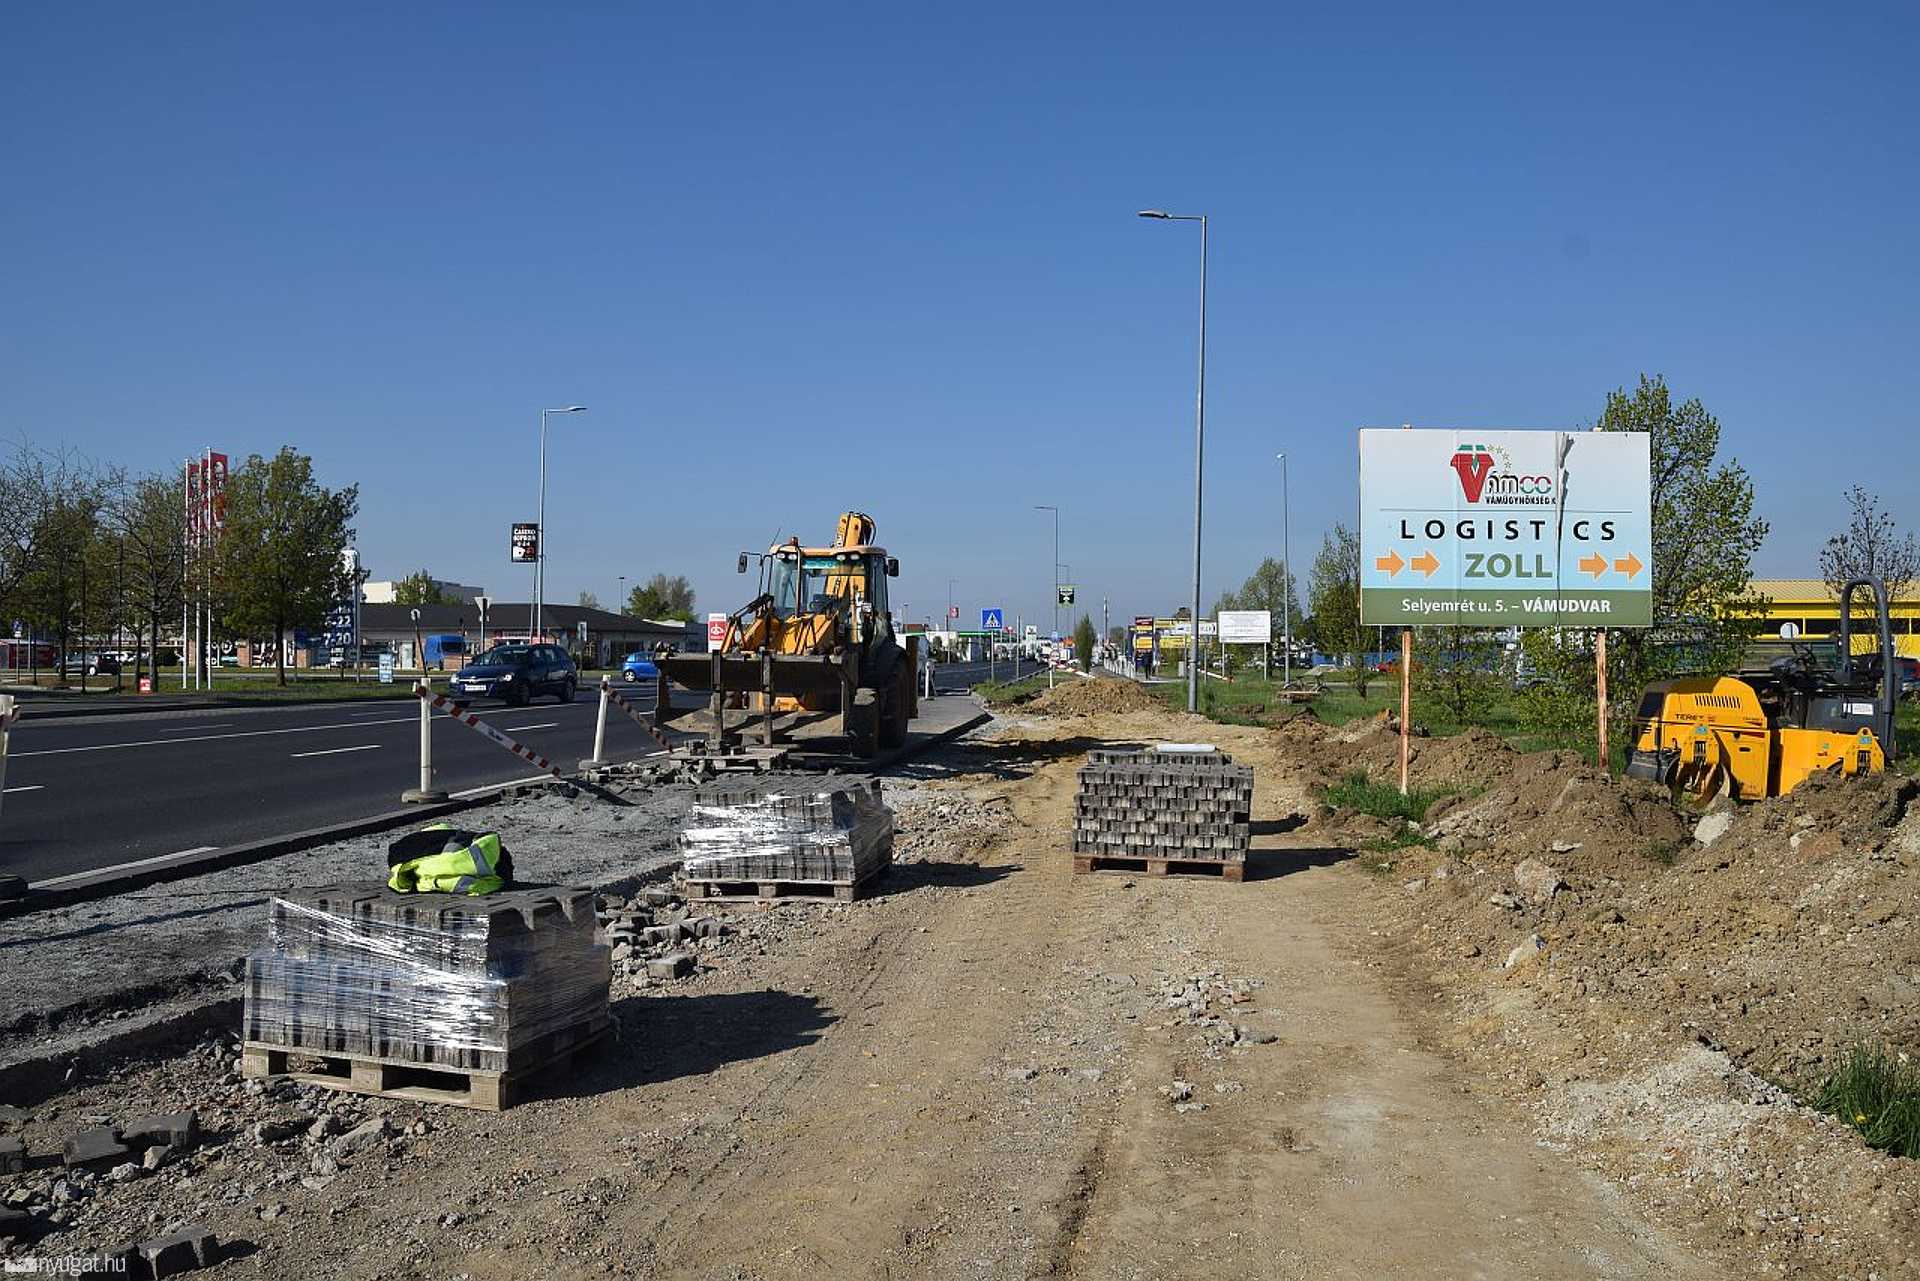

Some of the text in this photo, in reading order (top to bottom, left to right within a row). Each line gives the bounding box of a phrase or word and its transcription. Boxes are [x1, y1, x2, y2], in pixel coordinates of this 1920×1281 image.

[1401, 520, 1615, 541] LOGISTCS
[1464, 553, 1553, 578] ZOLL
[1401, 598, 1475, 616] Selyemrét
[1478, 603, 1491, 612] u.
[1495, 601, 1508, 612] 5.
[1522, 597, 1612, 613] VÁMUDVAR
